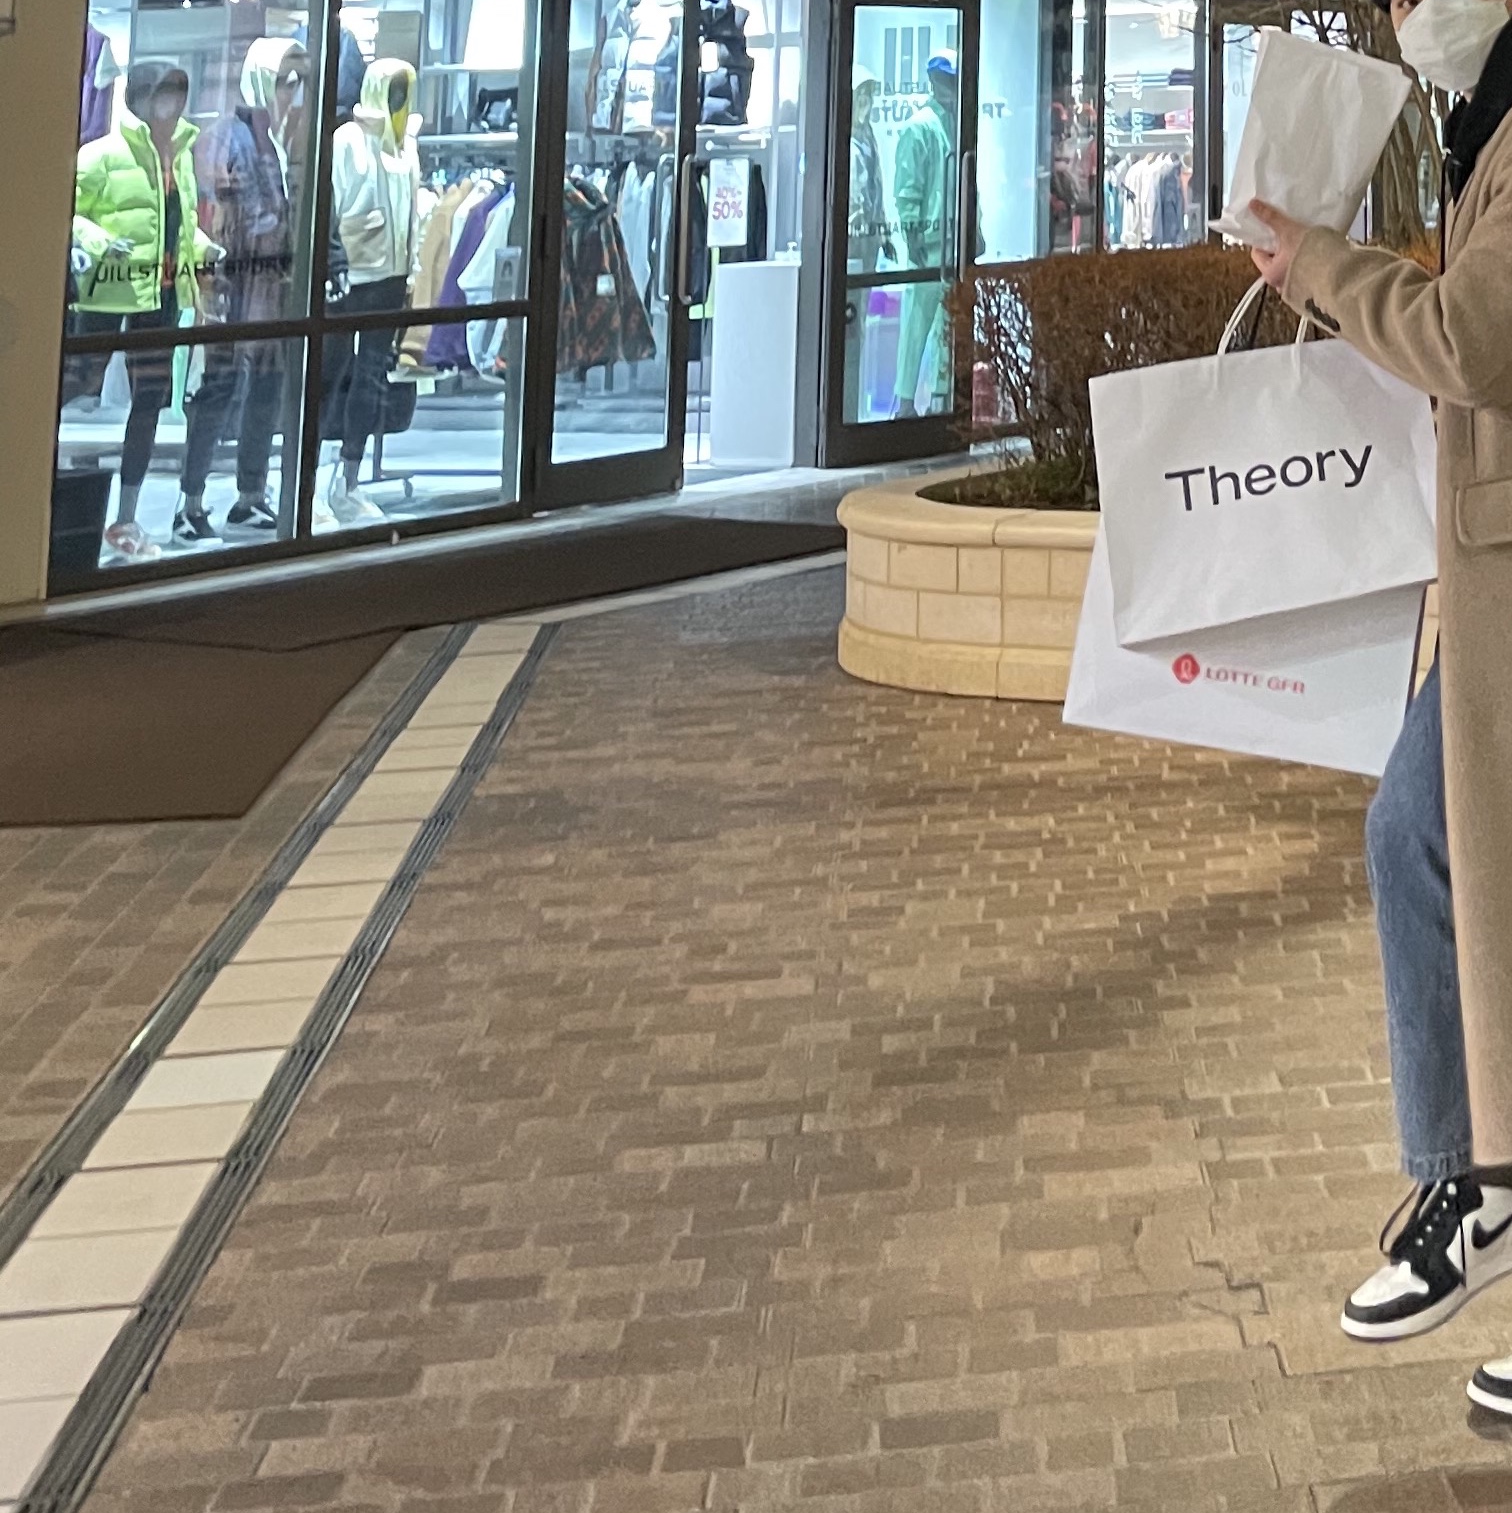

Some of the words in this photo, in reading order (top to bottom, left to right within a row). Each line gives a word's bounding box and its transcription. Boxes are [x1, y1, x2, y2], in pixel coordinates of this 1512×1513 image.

[712, 201, 743, 220] 50%
[1164, 444, 1373, 512] Theory
[1206, 667, 1258, 687] LOTTE
